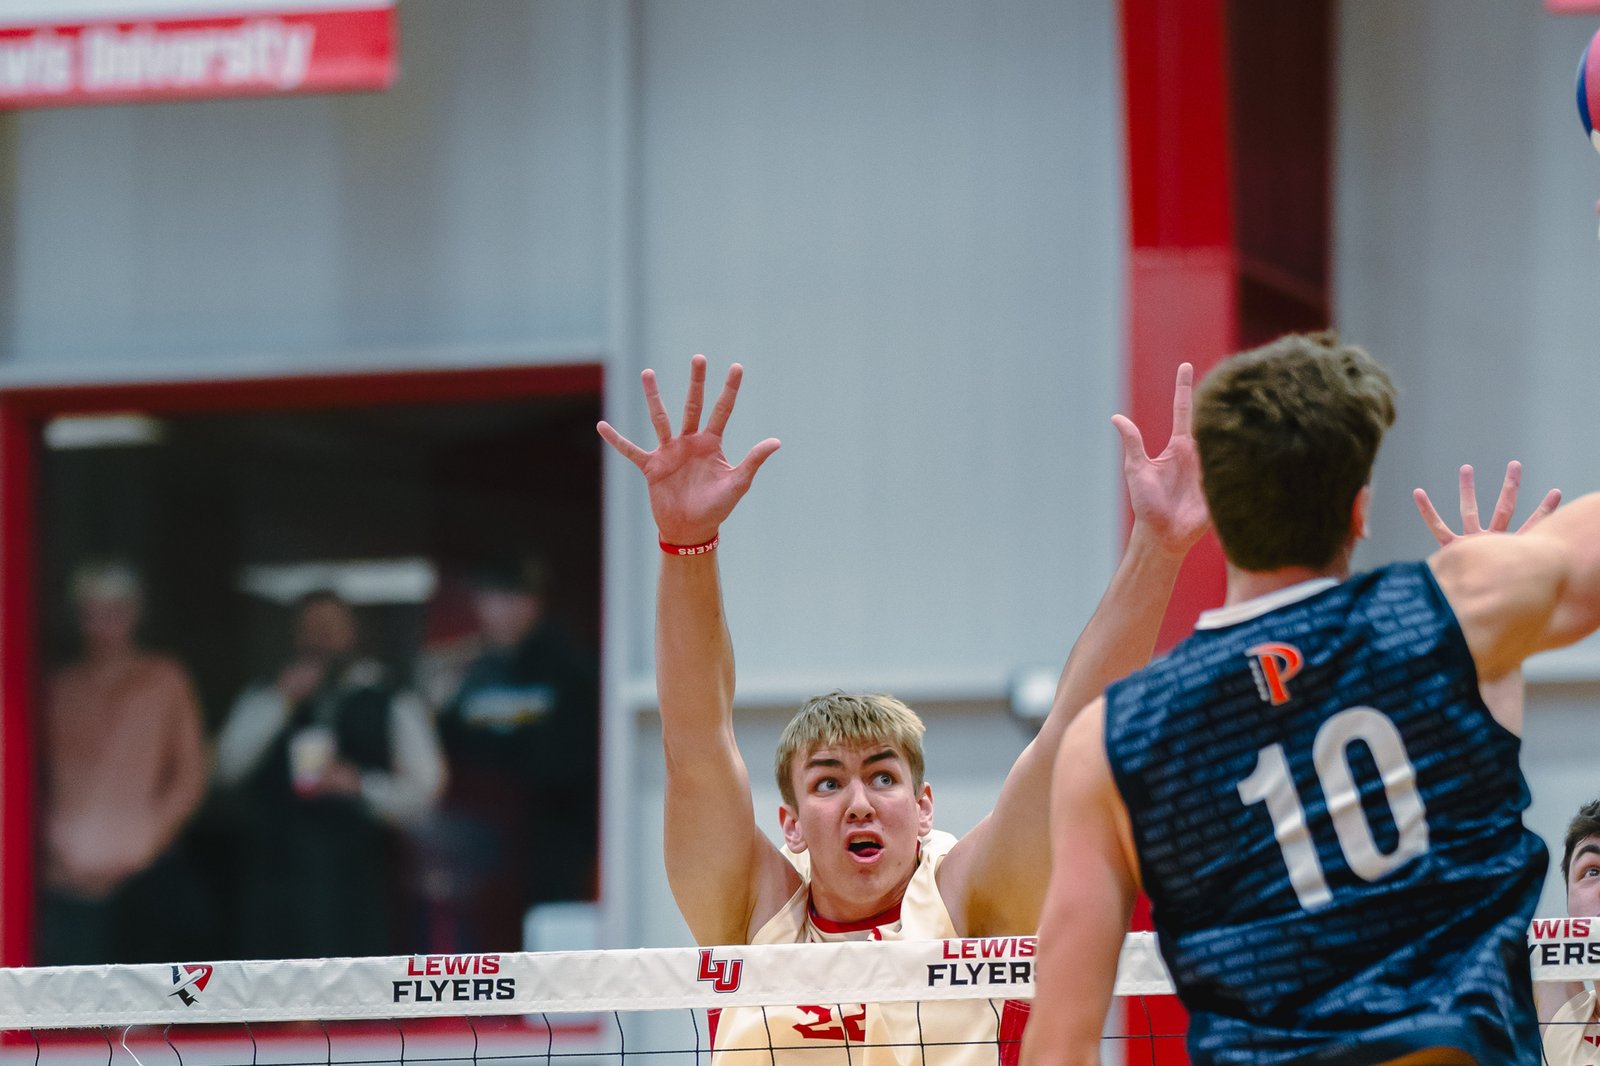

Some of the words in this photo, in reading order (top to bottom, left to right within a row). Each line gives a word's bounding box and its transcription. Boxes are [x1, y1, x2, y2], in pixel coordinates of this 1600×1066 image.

[1236, 705, 1431, 912] 10
[1526, 918, 1591, 939] WIS
[943, 937, 1038, 959] LEWIS
[407, 955, 501, 976] LEWIS
[697, 948, 743, 994] LU
[926, 961, 1038, 986] FLYER
[392, 978, 516, 1003] FLYERS
